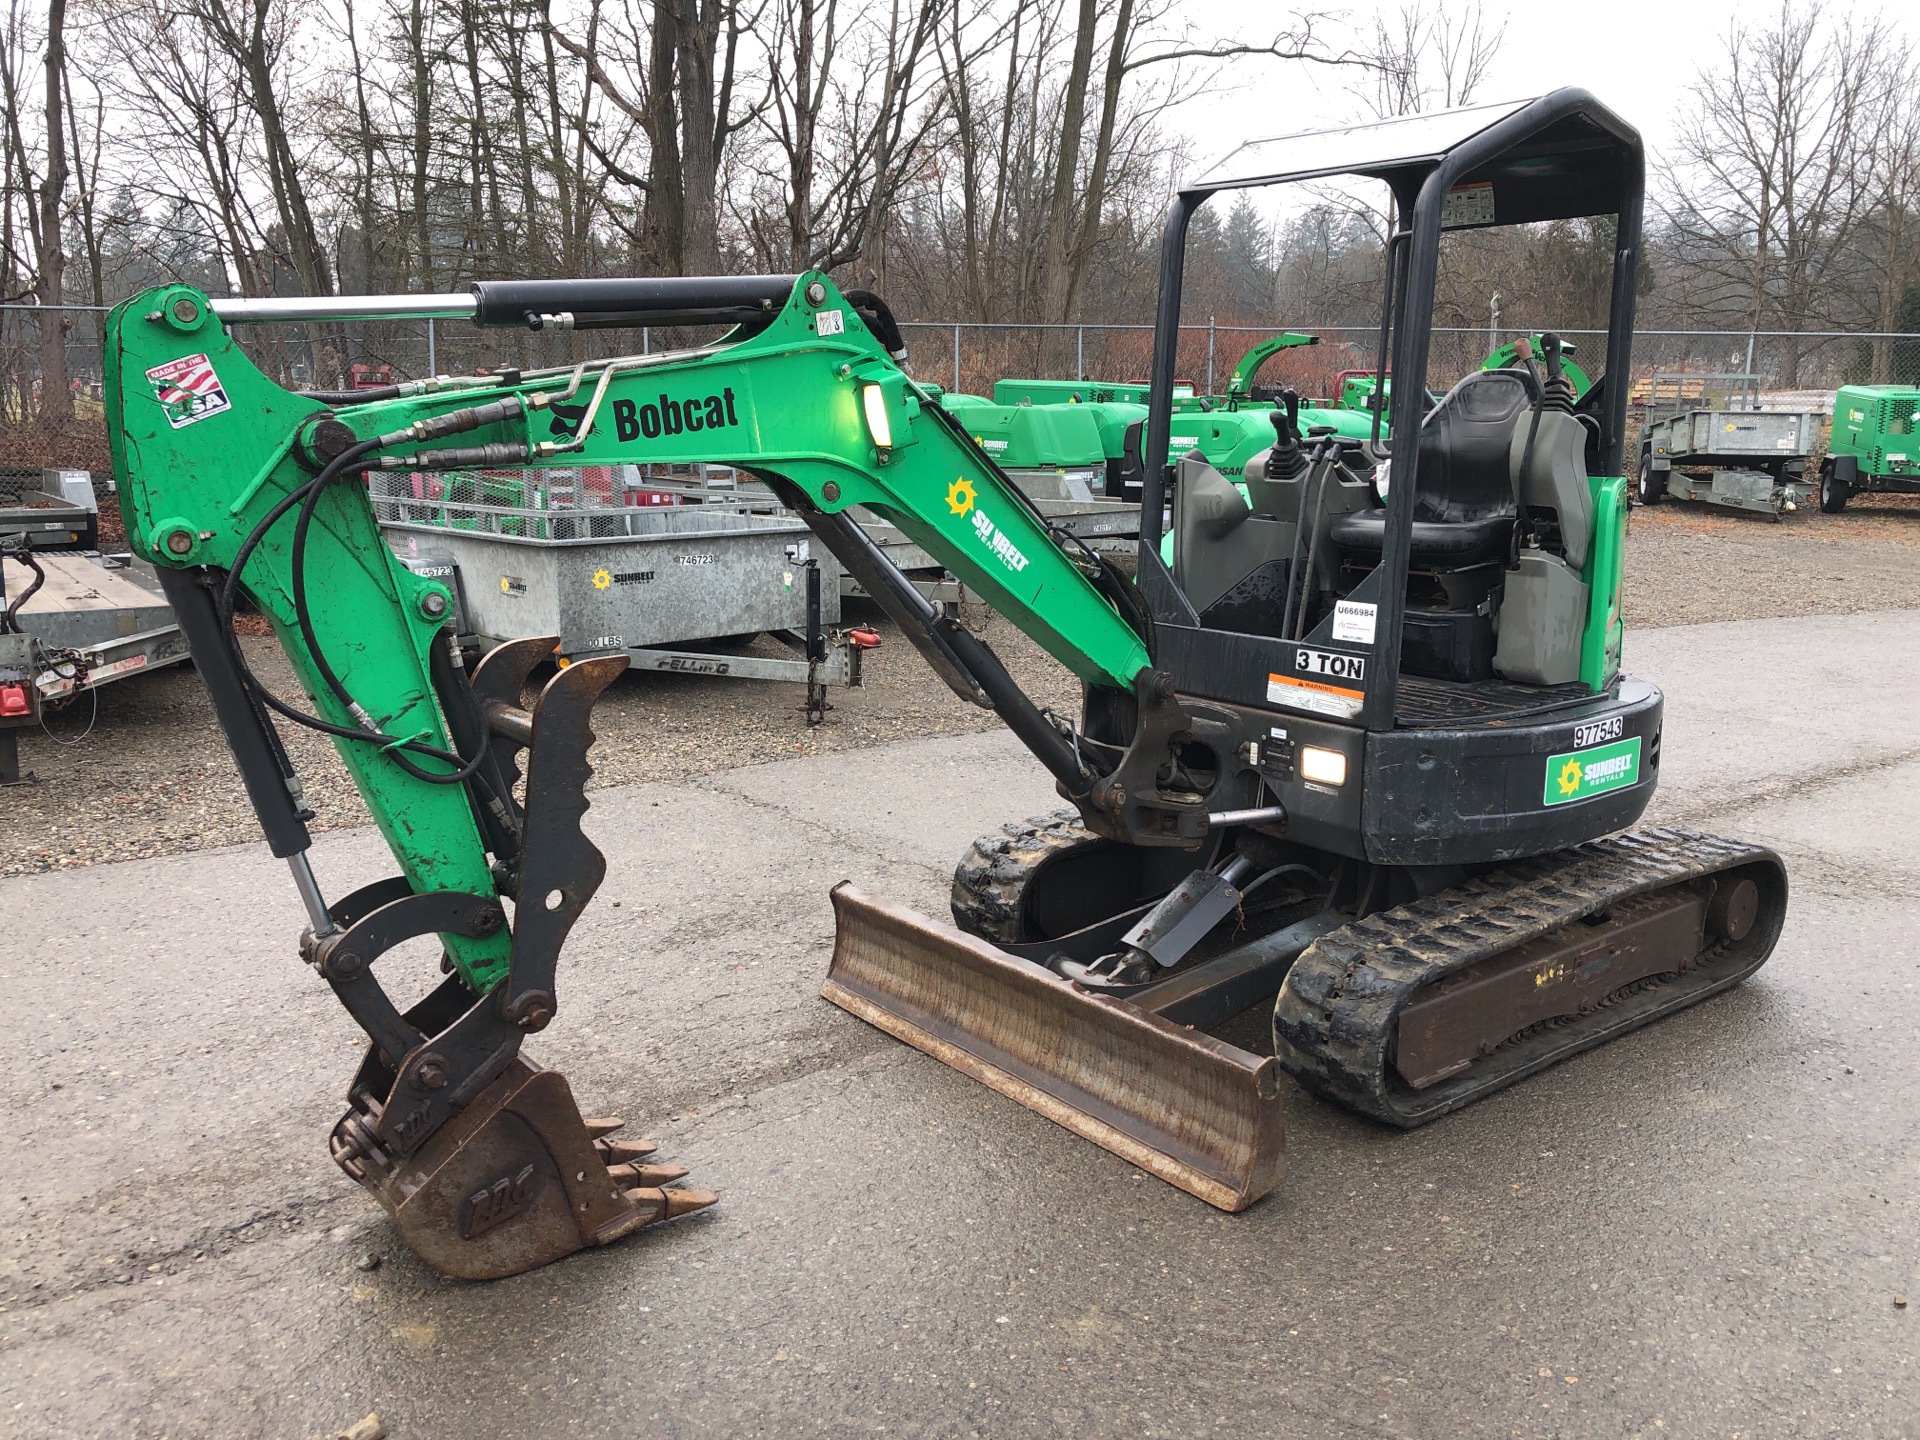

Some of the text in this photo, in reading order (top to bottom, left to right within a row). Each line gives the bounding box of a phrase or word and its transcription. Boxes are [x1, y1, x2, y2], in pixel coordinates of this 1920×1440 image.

[1254, 343, 1275, 356] Vermeer
[150, 356, 204, 378] MADE IN THE
[612, 387, 738, 443] Bobcat
[983, 439, 1009, 449] SUNBELT
[1170, 436, 1200, 445] SUNBELT
[975, 529, 1014, 571] RENTALS
[680, 555, 714, 566] 746723
[613, 570, 656, 584] SUNBELT
[1338, 606, 1375, 618] U666984
[602, 636, 622, 647] LBS
[1297, 651, 1363, 679] 3 TON
[1304, 682, 1333, 693] WARNING
[1575, 718, 1622, 747] 977543
[1584, 753, 1632, 781] SUNBELT
[1590, 771, 1625, 787] RENTALS
